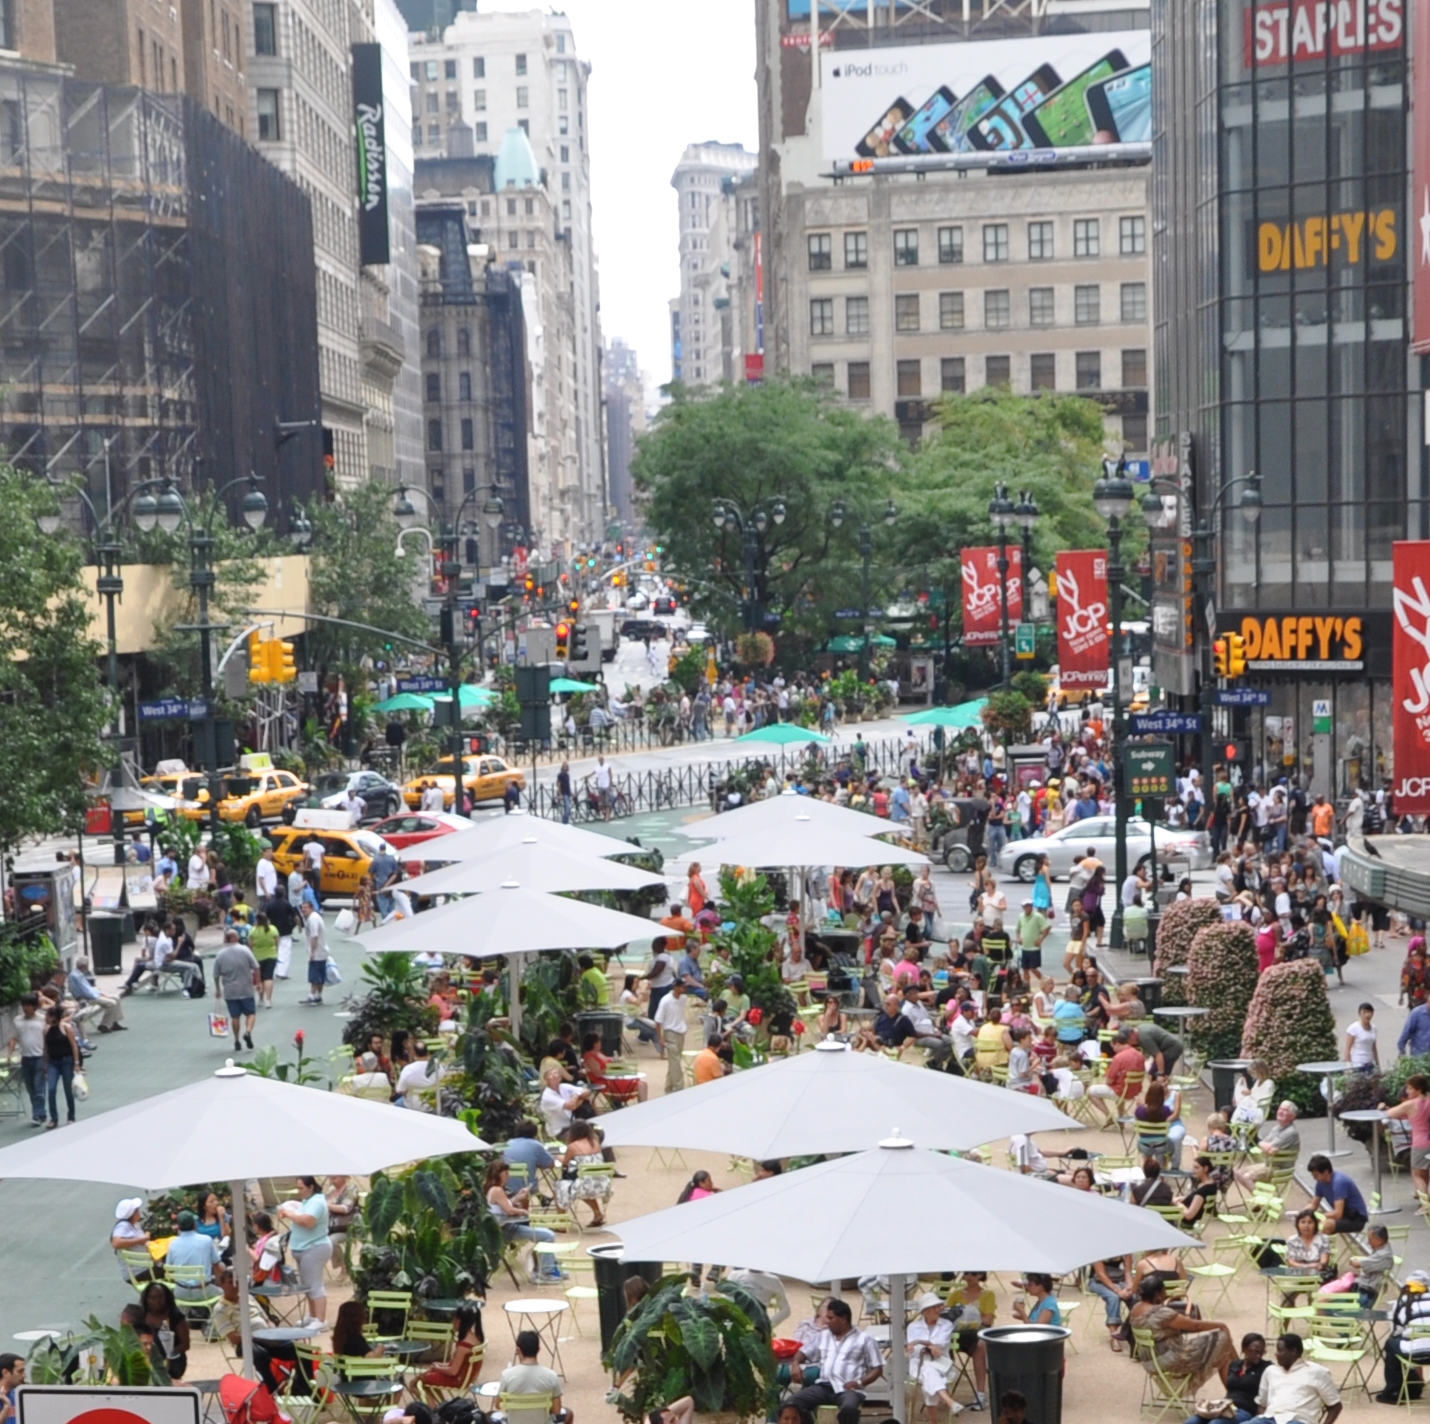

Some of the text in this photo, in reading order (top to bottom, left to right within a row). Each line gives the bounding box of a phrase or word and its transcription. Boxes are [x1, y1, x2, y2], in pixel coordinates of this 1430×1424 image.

[1255, 0, 1403, 61] STAPLES
[844, 62, 908, 77] iPod touch
[356, 103, 384, 211] Radisson
[1258, 209, 1397, 272] DAFFY'S
[1063, 602, 1106, 640] JCP
[1241, 616, 1362, 660] DAFFY'S
[1061, 671, 1108, 684] JCPenney
[1220, 694, 1241, 702] West
[1258, 693, 1267, 702] St
[142, 706, 165, 716] West
[1136, 718, 1197, 730] West 34th St
[1130, 750, 1166, 760] Subway
